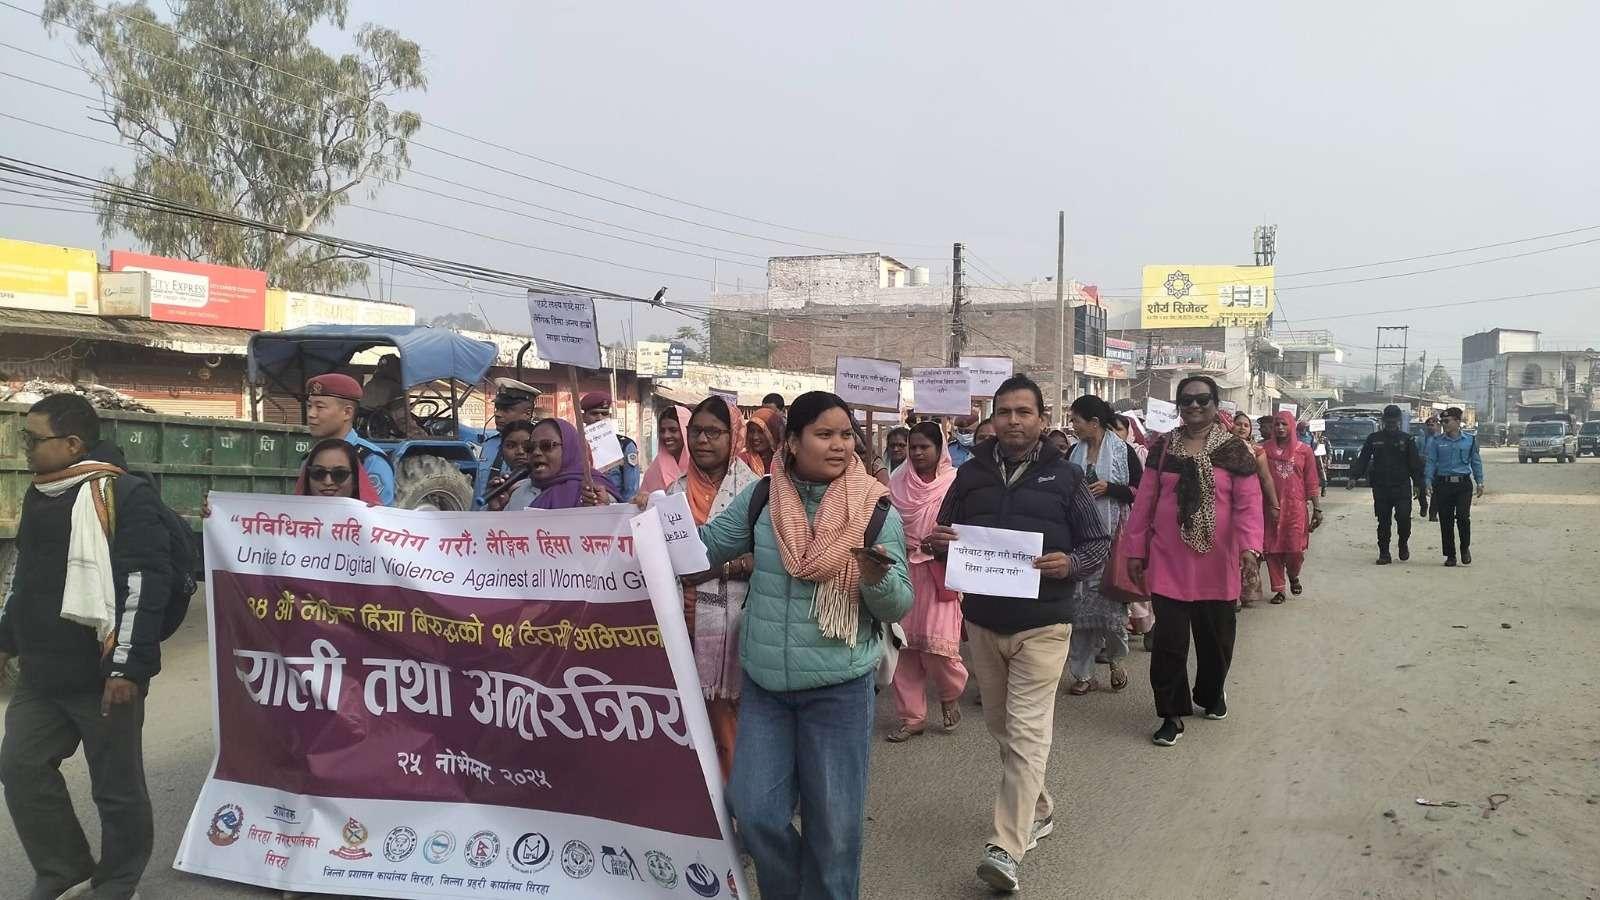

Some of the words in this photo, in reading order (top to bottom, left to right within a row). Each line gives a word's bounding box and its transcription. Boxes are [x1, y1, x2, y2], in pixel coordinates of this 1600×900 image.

[236, 545, 277, 566] Unite
[281, 551, 296, 568] to
[300, 553, 330, 570] end
[334, 553, 376, 577] Digital
[380, 556, 455, 583] Violence
[463, 568, 528, 591] Againest
[532, 568, 546, 589] all
[360, 603, 405, 632] हिंसा
[362, 658, 452, 717] तथा
[397, 752, 423, 776] २५
[499, 768, 552, 789] २०२५
[247, 824, 273, 845] सिरहा
[264, 849, 290, 871] सिरहा
